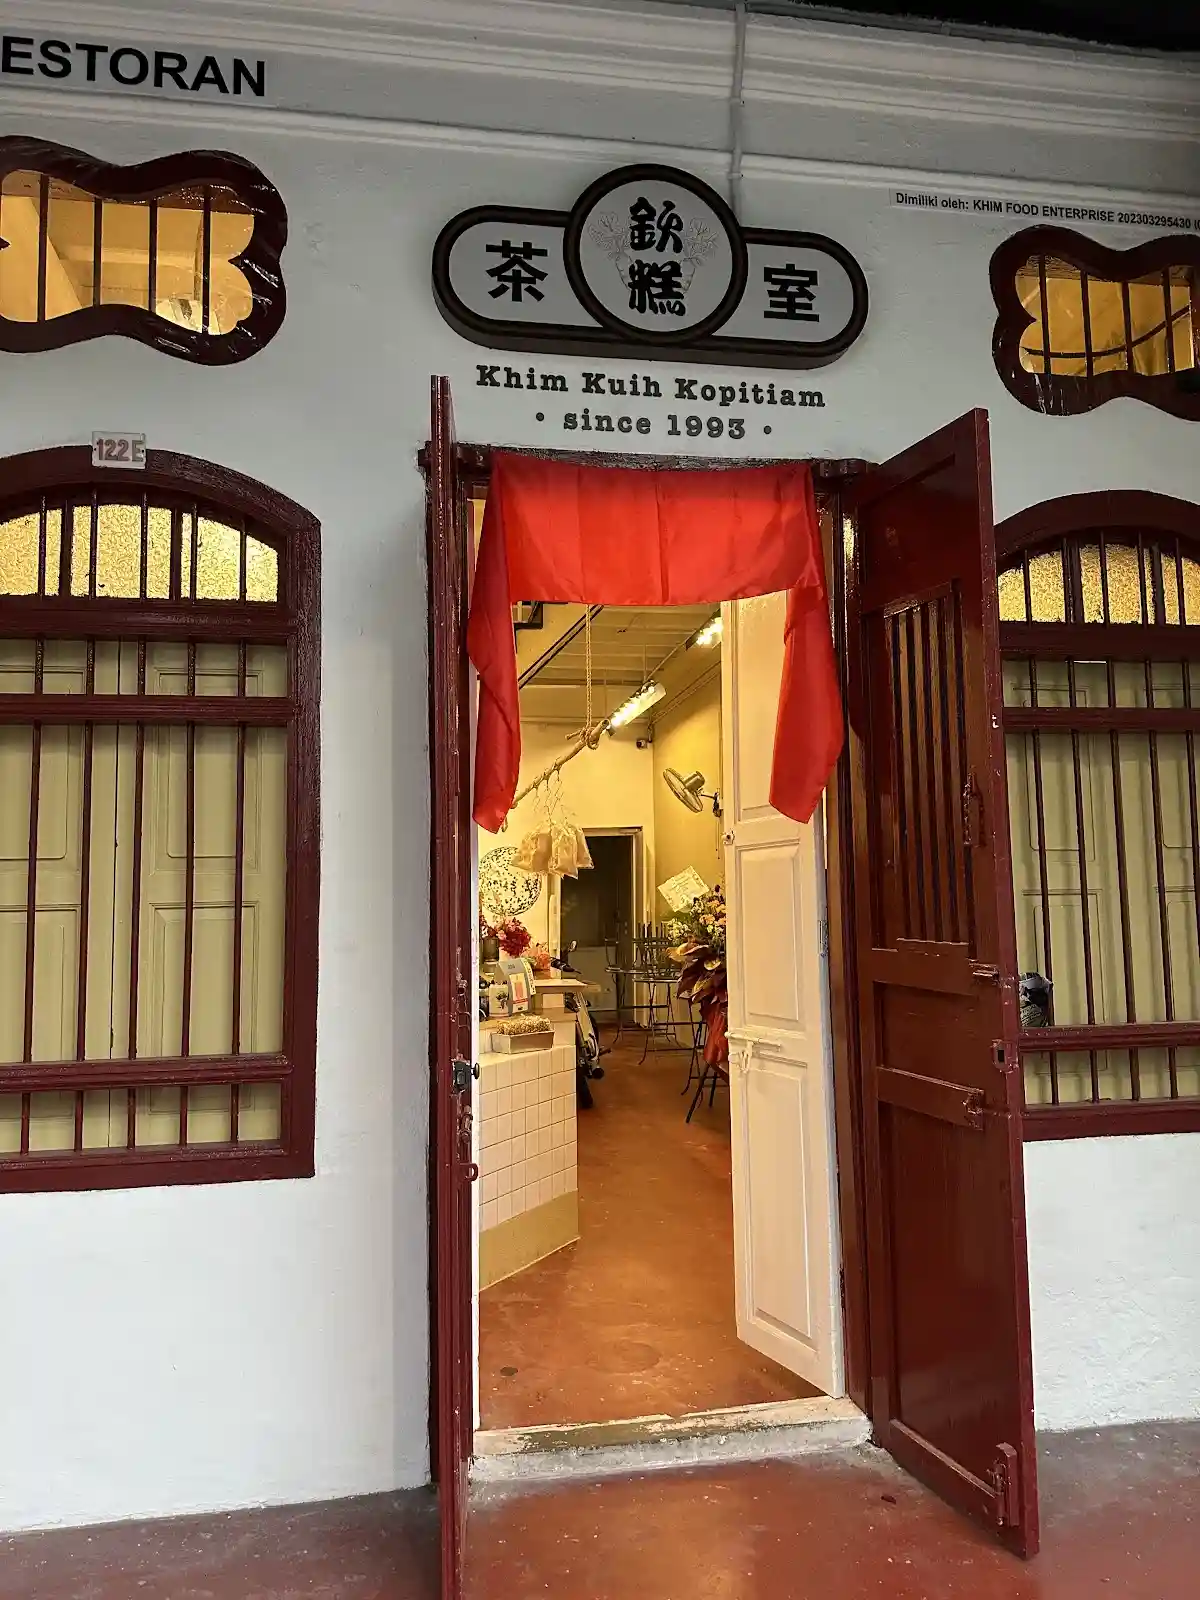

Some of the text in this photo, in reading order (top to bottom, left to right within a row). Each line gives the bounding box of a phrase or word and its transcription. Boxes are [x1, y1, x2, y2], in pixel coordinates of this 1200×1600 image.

[1, 35, 266, 97] ESTORAN
[896, 192, 938, 207] Dimiliki
[941, 197, 969, 210] oleh:
[973, 199, 1003, 213] KHIM
[1006, 202, 1039, 216] FOOD
[1042, 205, 1115, 222] ENTERPRISE
[1117, 212, 1191, 229] 202303295430
[485, 240, 549, 303] 茶
[763, 263, 820, 322] 室
[476, 364, 826, 407] Khim Kuih Kopitiam
[563, 408, 746, 440] since 1993
[97, 438, 145, 462] 122E
